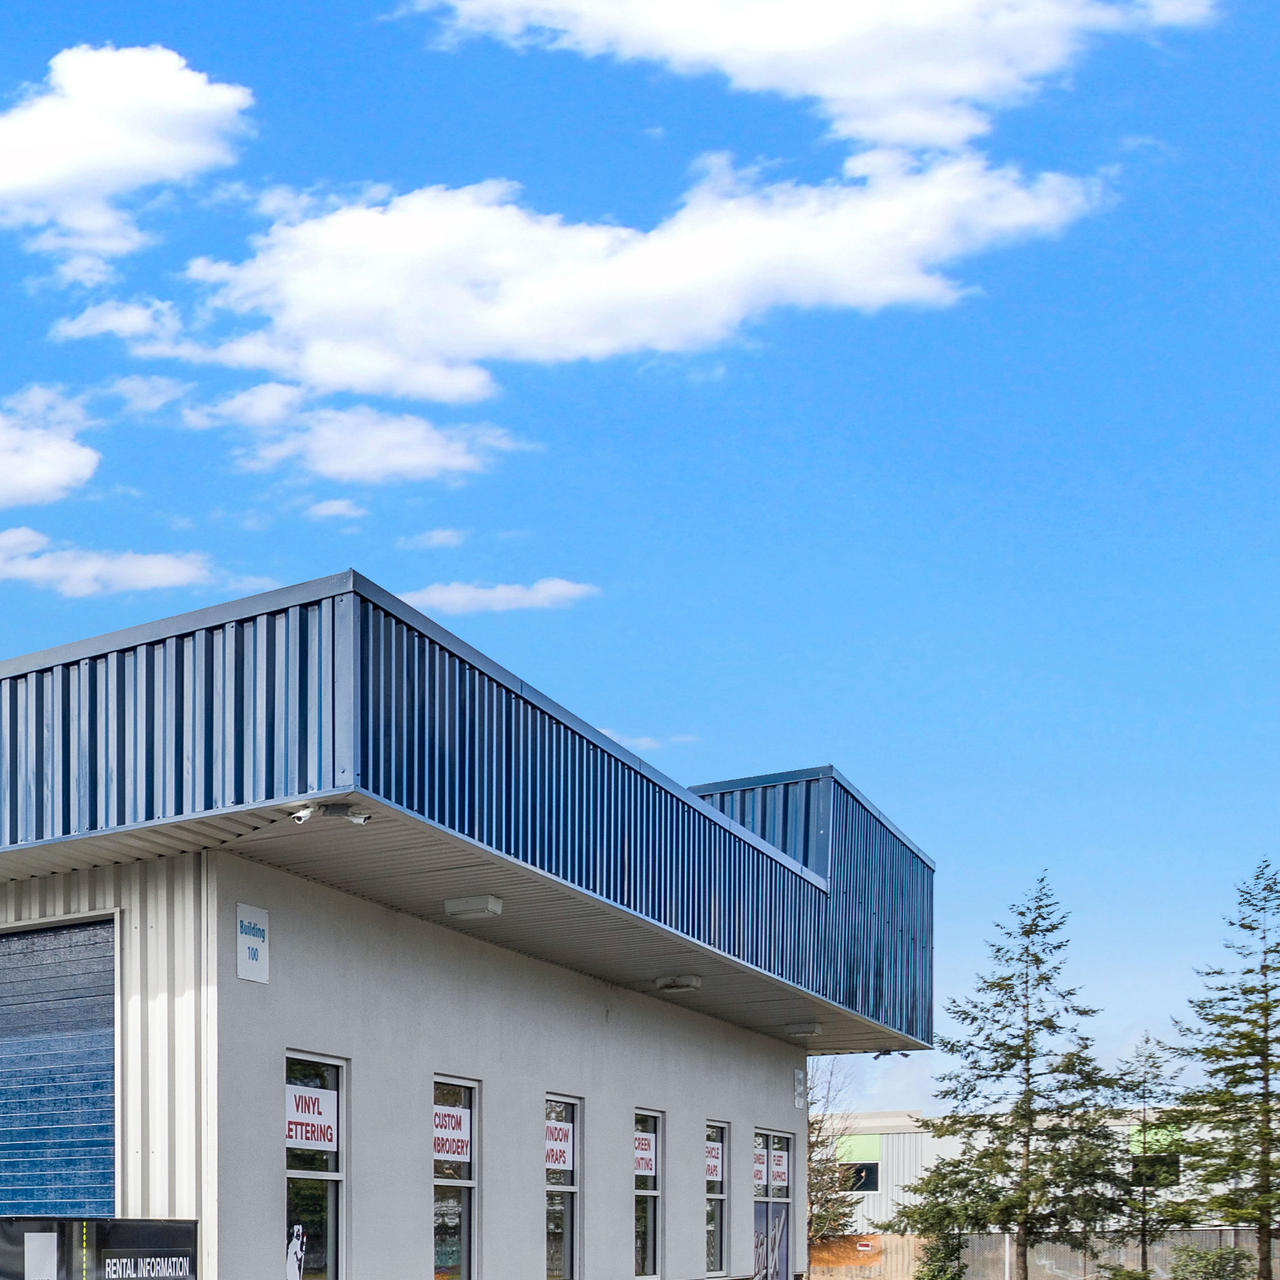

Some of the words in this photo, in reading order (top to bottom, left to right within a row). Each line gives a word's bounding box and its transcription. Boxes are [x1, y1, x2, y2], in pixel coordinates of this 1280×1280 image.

[240, 920, 266, 943] Building
[248, 946, 259, 962] 100
[294, 1094, 322, 1116] VINYL
[286, 1120, 333, 1142] ETTERING
[434, 1112, 462, 1131] CUSTOM
[106, 1258, 136, 1278] RENTAL
[138, 1257, 189, 1277] INFORMATION
